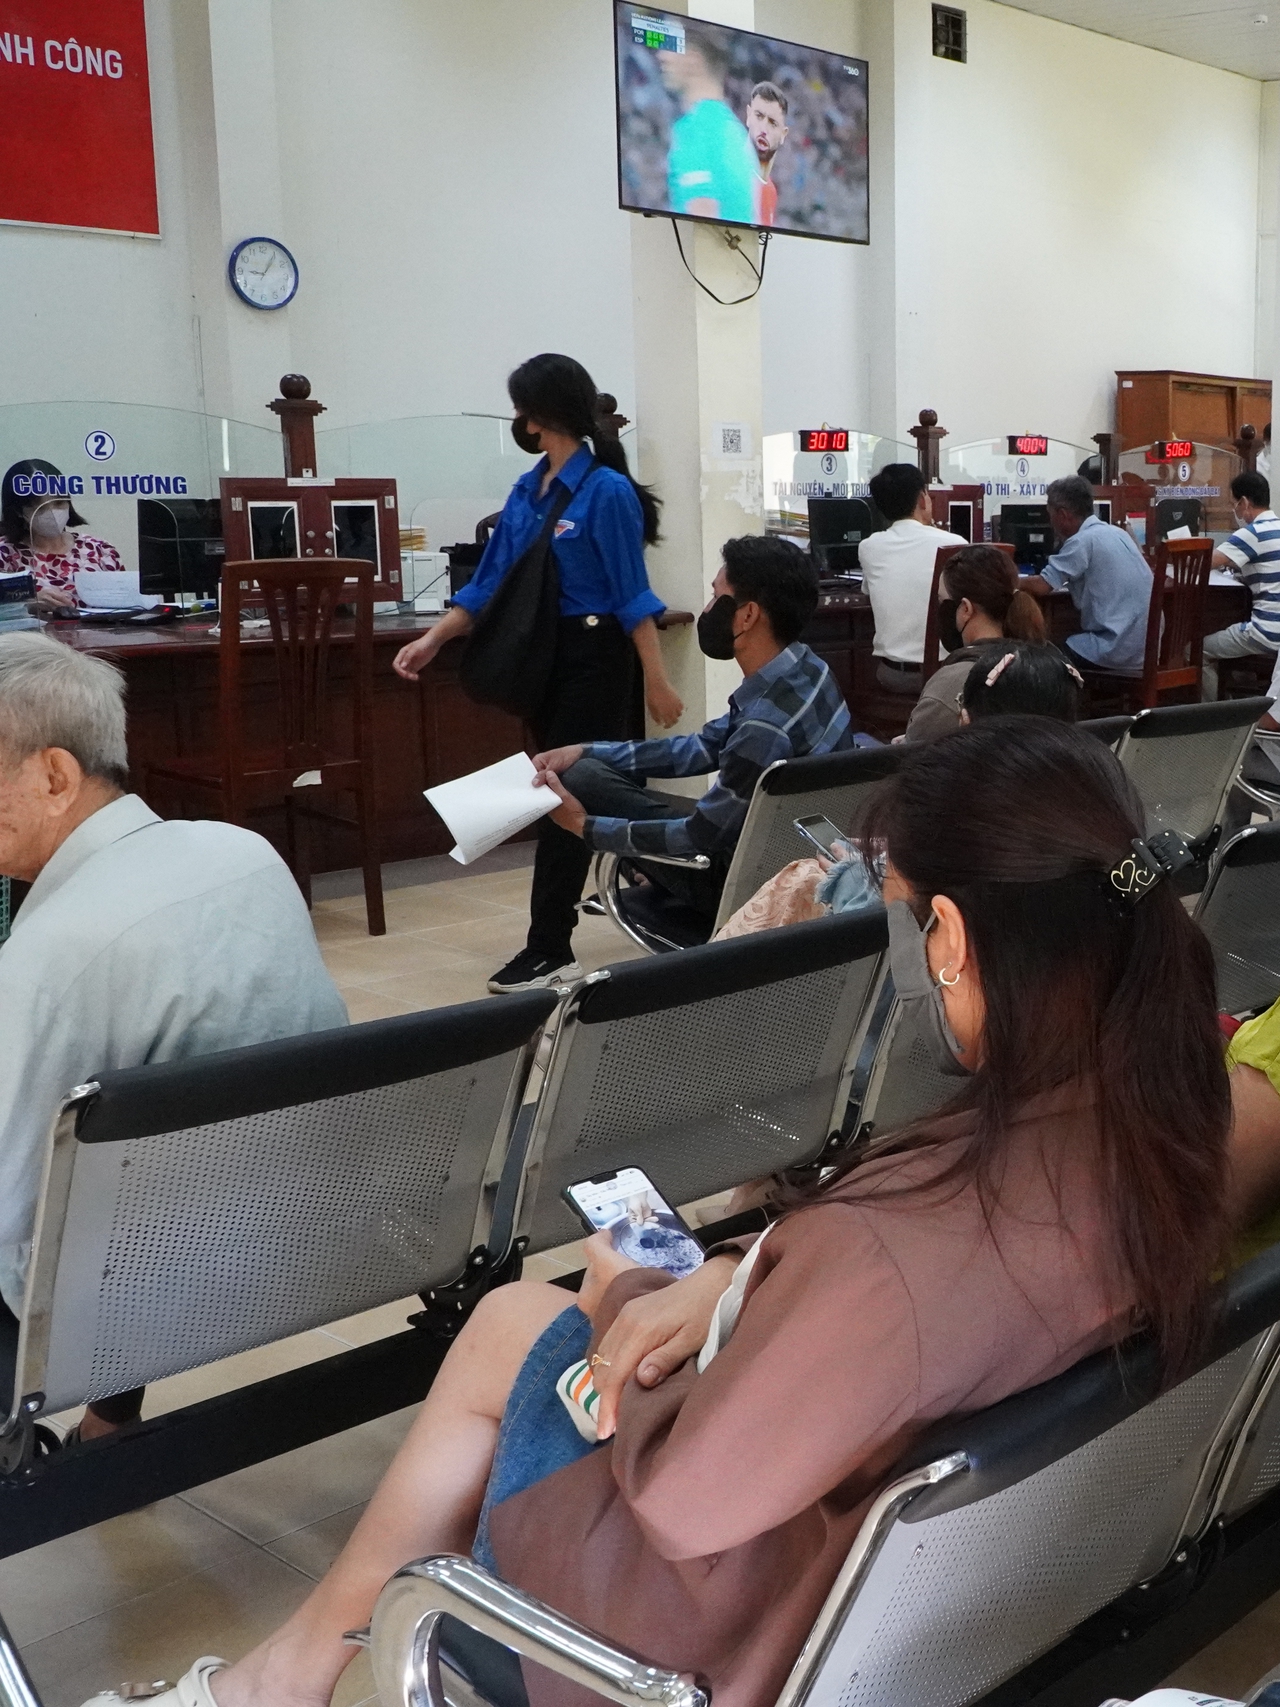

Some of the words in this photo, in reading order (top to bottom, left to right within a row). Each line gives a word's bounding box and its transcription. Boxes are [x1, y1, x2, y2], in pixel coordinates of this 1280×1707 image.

[44, 38, 123, 78] CÔNG
[94, 435, 107, 456] 2
[809, 432, 846, 449] 3010
[1017, 438, 1046, 453] 4004
[1166, 443, 1191, 457] 5060
[826, 456, 833, 472] 3
[1020, 461, 1025, 475] 4
[1182, 465, 1186, 478] 5
[14, 472, 84, 495] CÔNG
[91, 474, 187, 494] THƯƠNG
[773, 479, 787, 496] TÀI
[790, 480, 824, 496] NGUYÊN
[996, 484, 1010, 498] THỊ
[1020, 481, 1037, 495] XÂY
